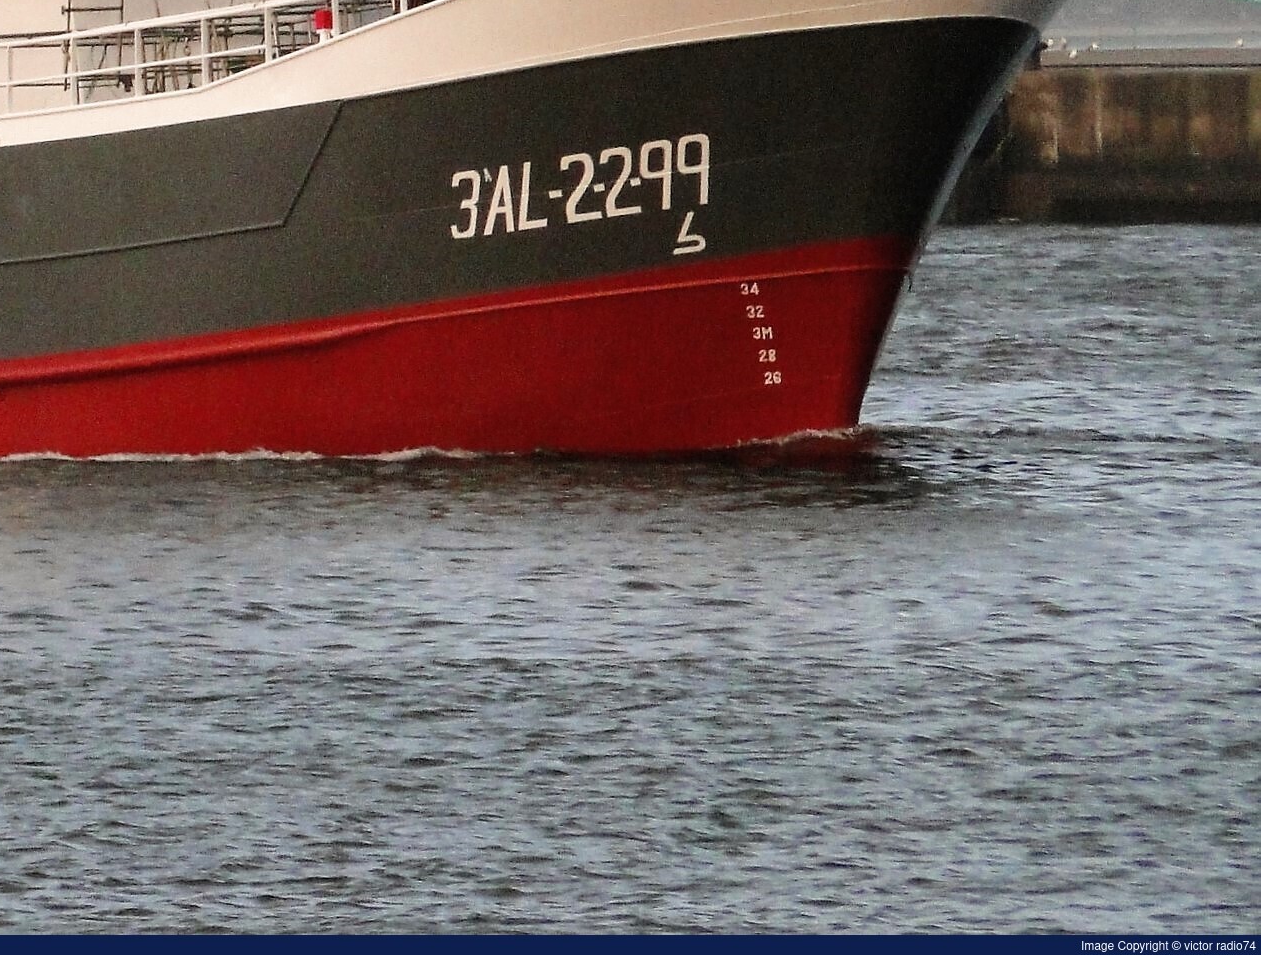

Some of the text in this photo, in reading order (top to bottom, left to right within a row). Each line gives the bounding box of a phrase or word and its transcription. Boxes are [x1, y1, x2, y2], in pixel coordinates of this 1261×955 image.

[740, 282, 760, 296] 34
[746, 305, 765, 319] 32
[752, 326, 773, 340] 3M
[758, 349, 776, 363] 28
[764, 371, 782, 385] 26
